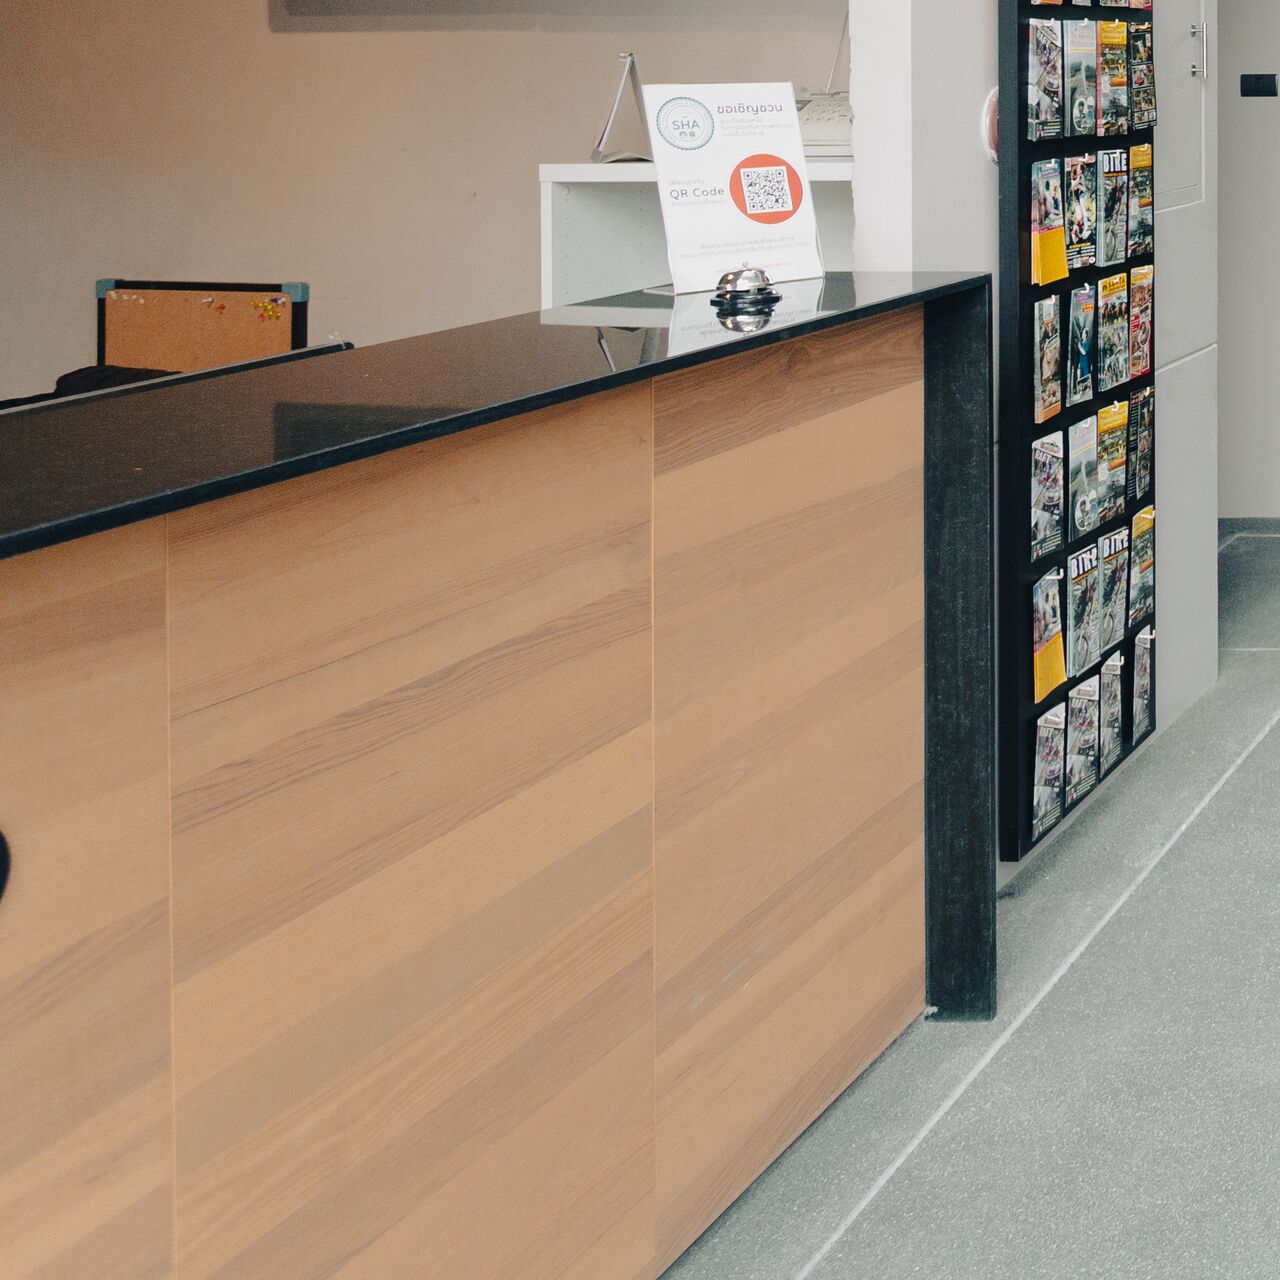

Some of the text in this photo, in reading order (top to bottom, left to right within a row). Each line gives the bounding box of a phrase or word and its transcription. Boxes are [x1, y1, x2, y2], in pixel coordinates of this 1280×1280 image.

[717, 103, 783, 115] ขอเชิญชวน
[672, 120, 700, 130] SHA
[1103, 152, 1127, 173] BIKE
[670, 187, 724, 200] QR Code
[1103, 530, 1129, 557] BIKE
